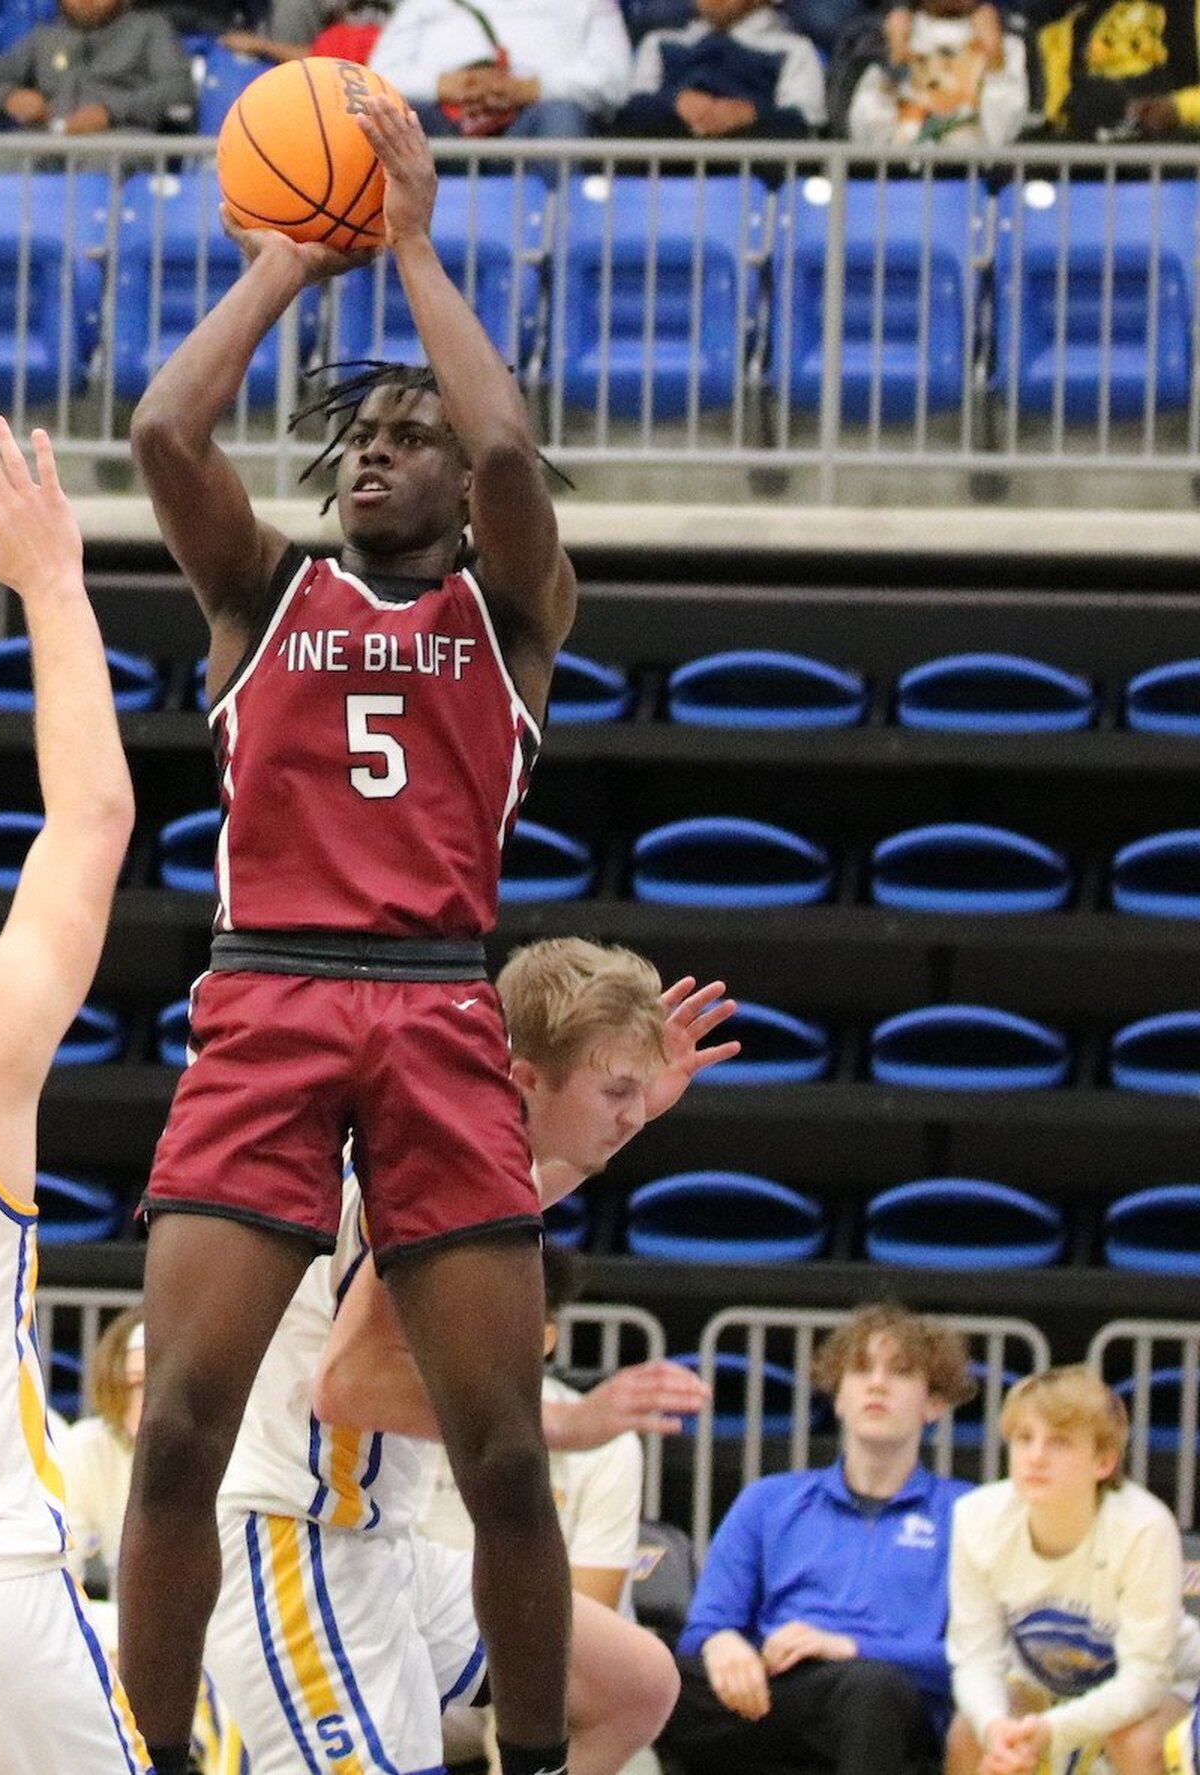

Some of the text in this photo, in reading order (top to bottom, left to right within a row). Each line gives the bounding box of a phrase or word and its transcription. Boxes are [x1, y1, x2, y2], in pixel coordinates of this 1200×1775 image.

[277, 629, 477, 680] INE BLUFF
[346, 693, 409, 799] 5
[315, 1713, 355, 1760] S
